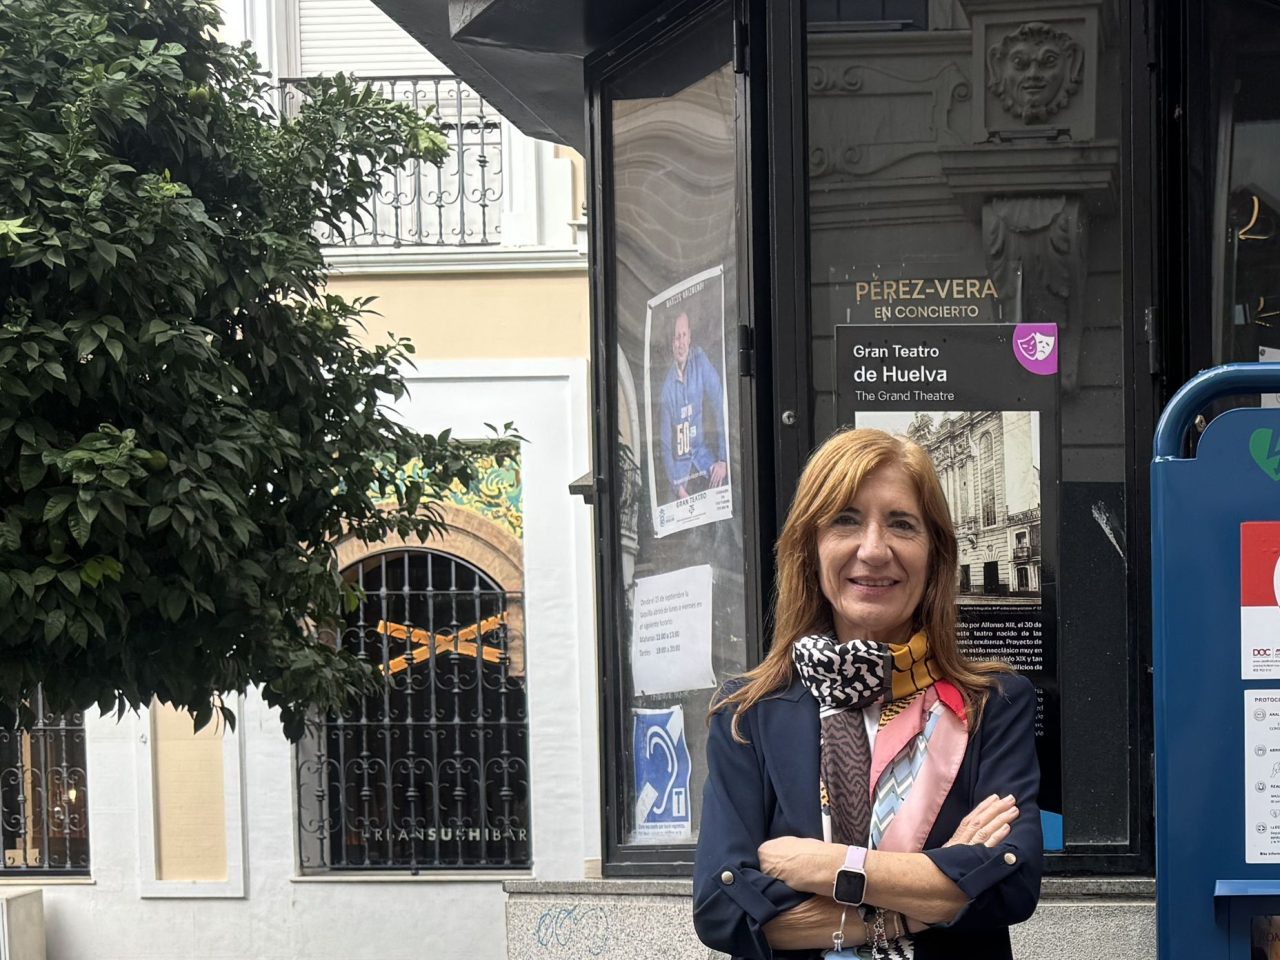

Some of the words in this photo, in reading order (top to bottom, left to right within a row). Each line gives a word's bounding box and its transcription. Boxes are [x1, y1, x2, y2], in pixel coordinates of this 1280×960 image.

[855, 275, 998, 300] PÉREZ-VERA
[875, 306, 891, 319] EN
[895, 305, 979, 318] CONCIERTO
[853, 345, 888, 358] Gran
[892, 344, 939, 358] Teatro
[853, 366, 877, 382] de
[883, 366, 948, 382] Huelva
[855, 390, 876, 401] The
[878, 390, 911, 401] Grand
[913, 390, 955, 401] Theatre
[1252, 648, 1271, 656] DOC
[674, 790, 683, 815] T
